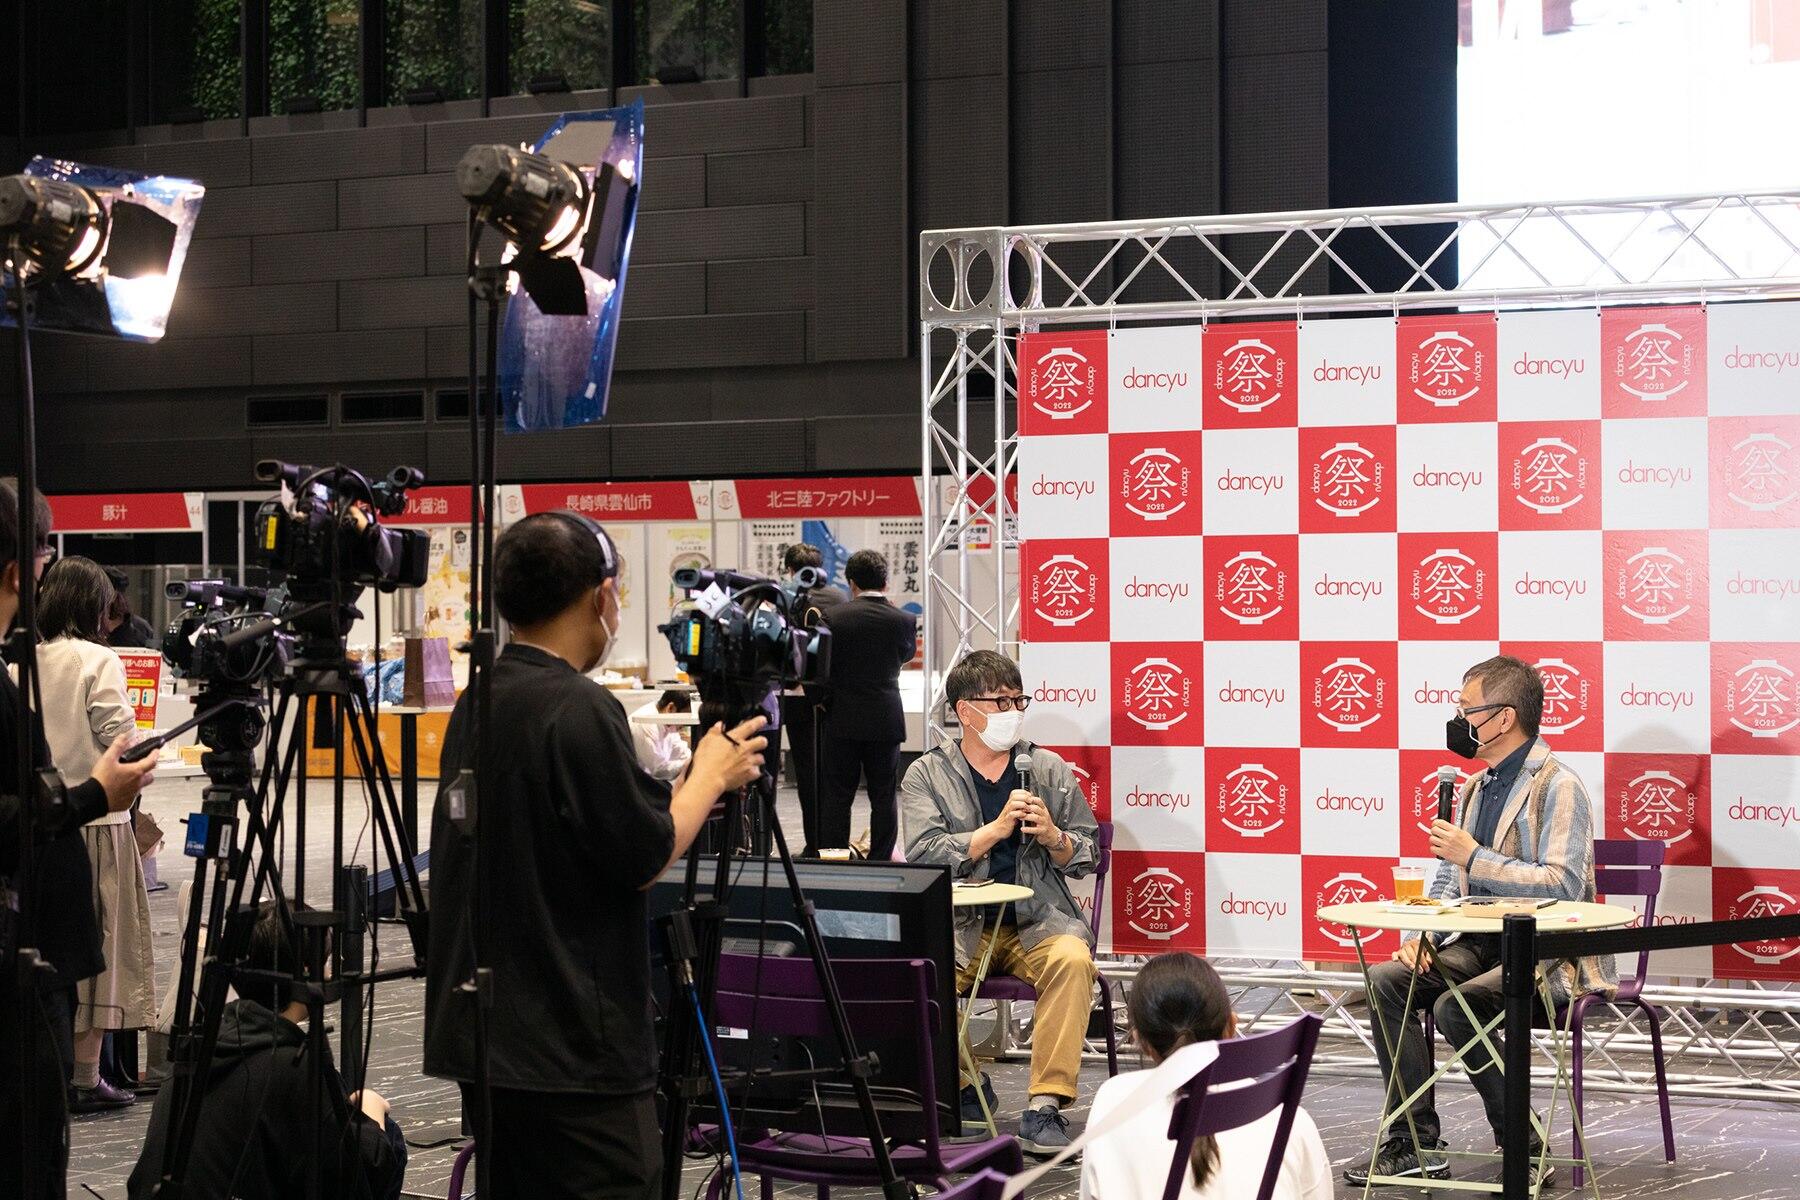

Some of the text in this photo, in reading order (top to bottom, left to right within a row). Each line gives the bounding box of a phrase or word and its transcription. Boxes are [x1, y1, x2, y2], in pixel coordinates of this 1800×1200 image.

[1227, 352, 1272, 393] 祭
[1275, 358, 1285, 387] dancyu
[1314, 359, 1380, 385] dancyu
[1409, 353, 1420, 383] dancyu
[1423, 343, 1470, 386] 祭
[1473, 351, 1484, 381] dancyu
[1514, 352, 1584, 379] dancyu
[1628, 336, 1677, 380] 祭
[1725, 345, 1799, 373] dancyu
[1029, 369, 1038, 397] dancyu
[1041, 359, 1084, 400] 祭
[1087, 366, 1096, 395] dancyu
[1123, 367, 1187, 392] dancyu
[1214, 361, 1224, 389] dancyu
[1121, 469, 1131, 497] dancyu
[1134, 460, 1177, 501] 祭
[1180, 467, 1191, 496] dancyu
[1218, 469, 1283, 495] dancyu
[1311, 464, 1321, 493] dancyu
[1324, 454, 1370, 496] 祭
[1373, 462, 1384, 492] dancyu
[1413, 464, 1481, 491] dancyu
[1512, 460, 1522, 489] dancyu
[1525, 450, 1574, 493] 祭
[1577, 458, 1588, 488] dancyu
[1619, 460, 1691, 488] dancyu
[695, 495, 709, 507] 42
[766, 489, 890, 508] 北三陸ファクトリー
[1032, 474, 1094, 500] dancyu
[102, 504, 128, 521] 豚汁
[190, 505, 200, 515] 44
[402, 497, 449, 515] ル醤油
[566, 494, 652, 512] 長崎県雲仙市
[1030, 575, 1040, 603] dancyu
[1042, 566, 1085, 607] 祭
[1088, 574, 1098, 602] dancyu
[1125, 576, 1188, 602] dancyu
[1216, 572, 1225, 601] dancyu
[1228, 564, 1273, 605] 祭
[1276, 571, 1287, 600] dancyu
[1315, 573, 1381, 601] dancyu
[1411, 570, 1421, 599] dancyu
[1424, 560, 1472, 604] 祭
[1475, 569, 1485, 599] dancyu
[1515, 572, 1586, 600] dancyu
[1616, 569, 1628, 599] dancyu
[1631, 560, 1679, 603] 祭
[1727, 571, 1800, 600] dancyu
[1034, 681, 1096, 707] dancyu
[1123, 678, 1132, 706] dancyu
[1135, 669, 1181, 711] 祭
[1182, 678, 1192, 706] dancyu
[1219, 680, 1284, 708] dancyu
[1312, 678, 1323, 707] dancyu
[1325, 669, 1372, 713] 祭
[1375, 678, 1385, 708] dancyu
[1415, 681, 1460, 704] danc
[1579, 680, 1590, 710] dancyu
[1621, 683, 1693, 712] dancyu
[1739, 672, 1790, 716] 祭
[1090, 781, 1099, 811] dancyu
[1126, 785, 1189, 812] dancyu
[1217, 784, 1227, 813] dancyu
[1229, 775, 1276, 817] 祭
[1278, 785, 1288, 814] dancyu
[1317, 788, 1383, 816] dancyu
[1412, 787, 1423, 817] dancyu
[1618, 791, 1630, 821] dancyu
[1633, 782, 1682, 826] 祭
[1686, 793, 1697, 823] dancyu
[1124, 887, 1134, 915] dancyu
[1136, 879, 1182, 920] 祭
[1183, 888, 1193, 917] dancyu
[1221, 892, 1286, 921] dancyu
